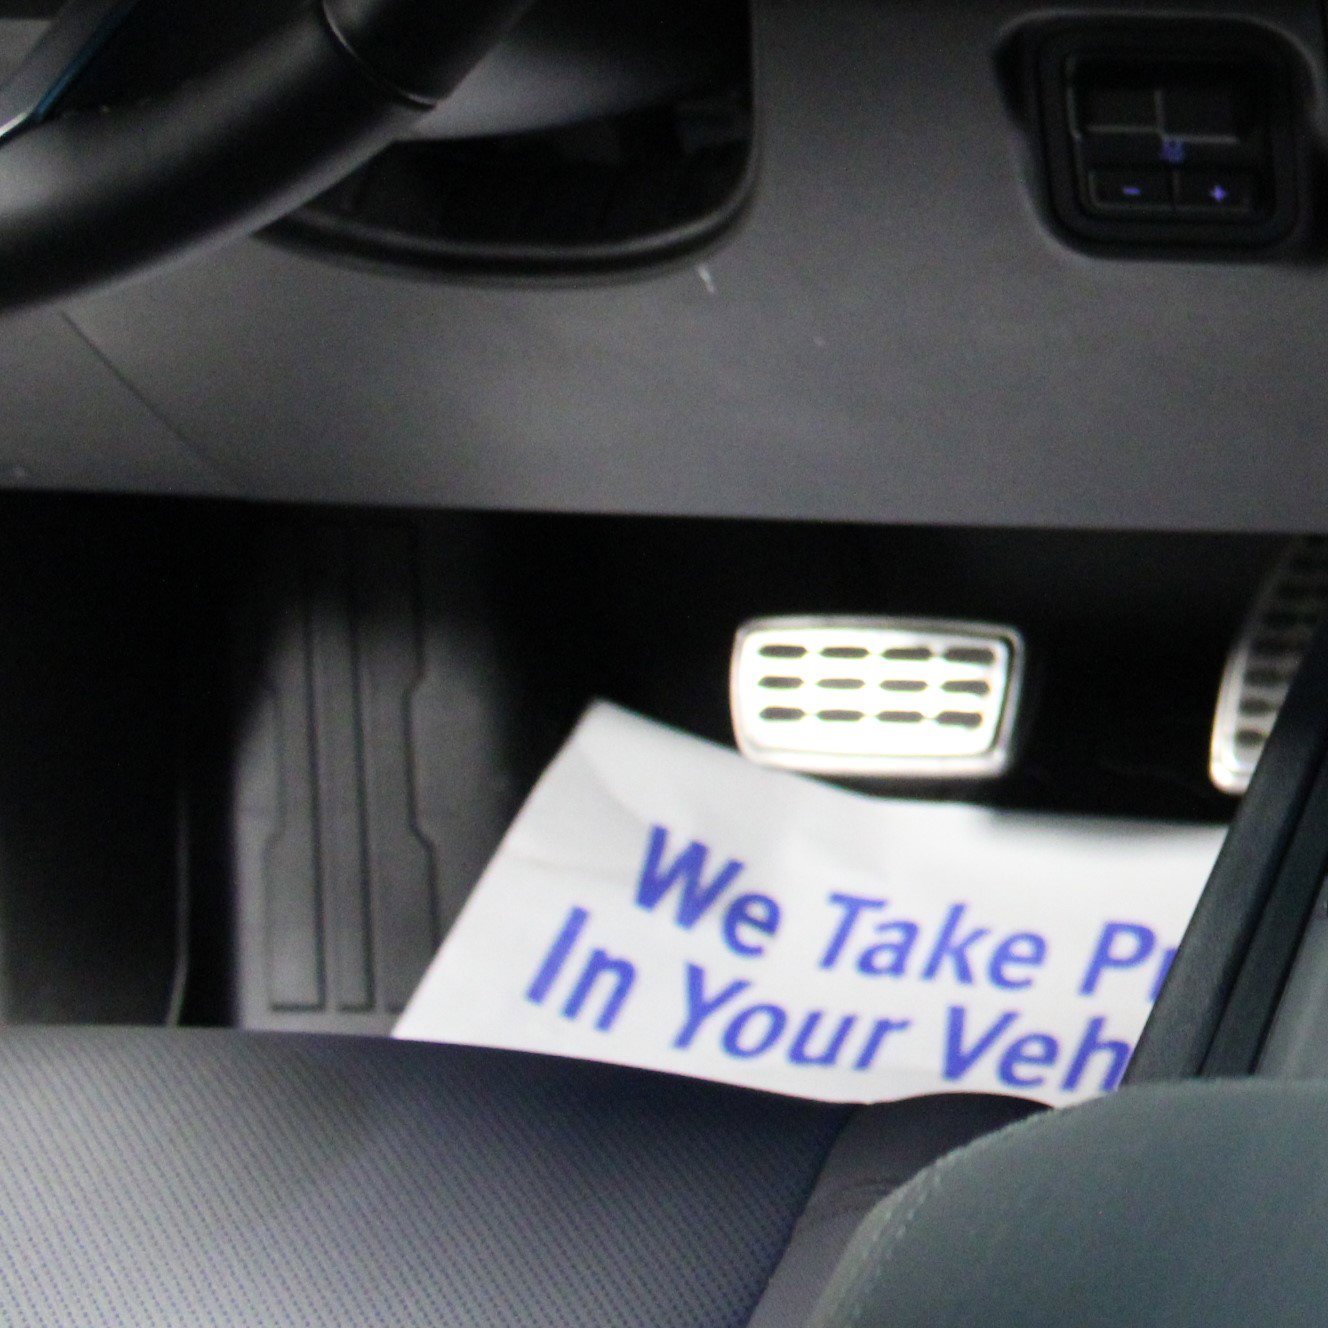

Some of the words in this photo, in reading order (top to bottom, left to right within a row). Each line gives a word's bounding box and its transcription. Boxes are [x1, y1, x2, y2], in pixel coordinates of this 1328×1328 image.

[523, 904, 638, 1033] In
[669, 960, 911, 1072] Your
[634, 822, 783, 958] We
[816, 891, 1048, 991] Take
